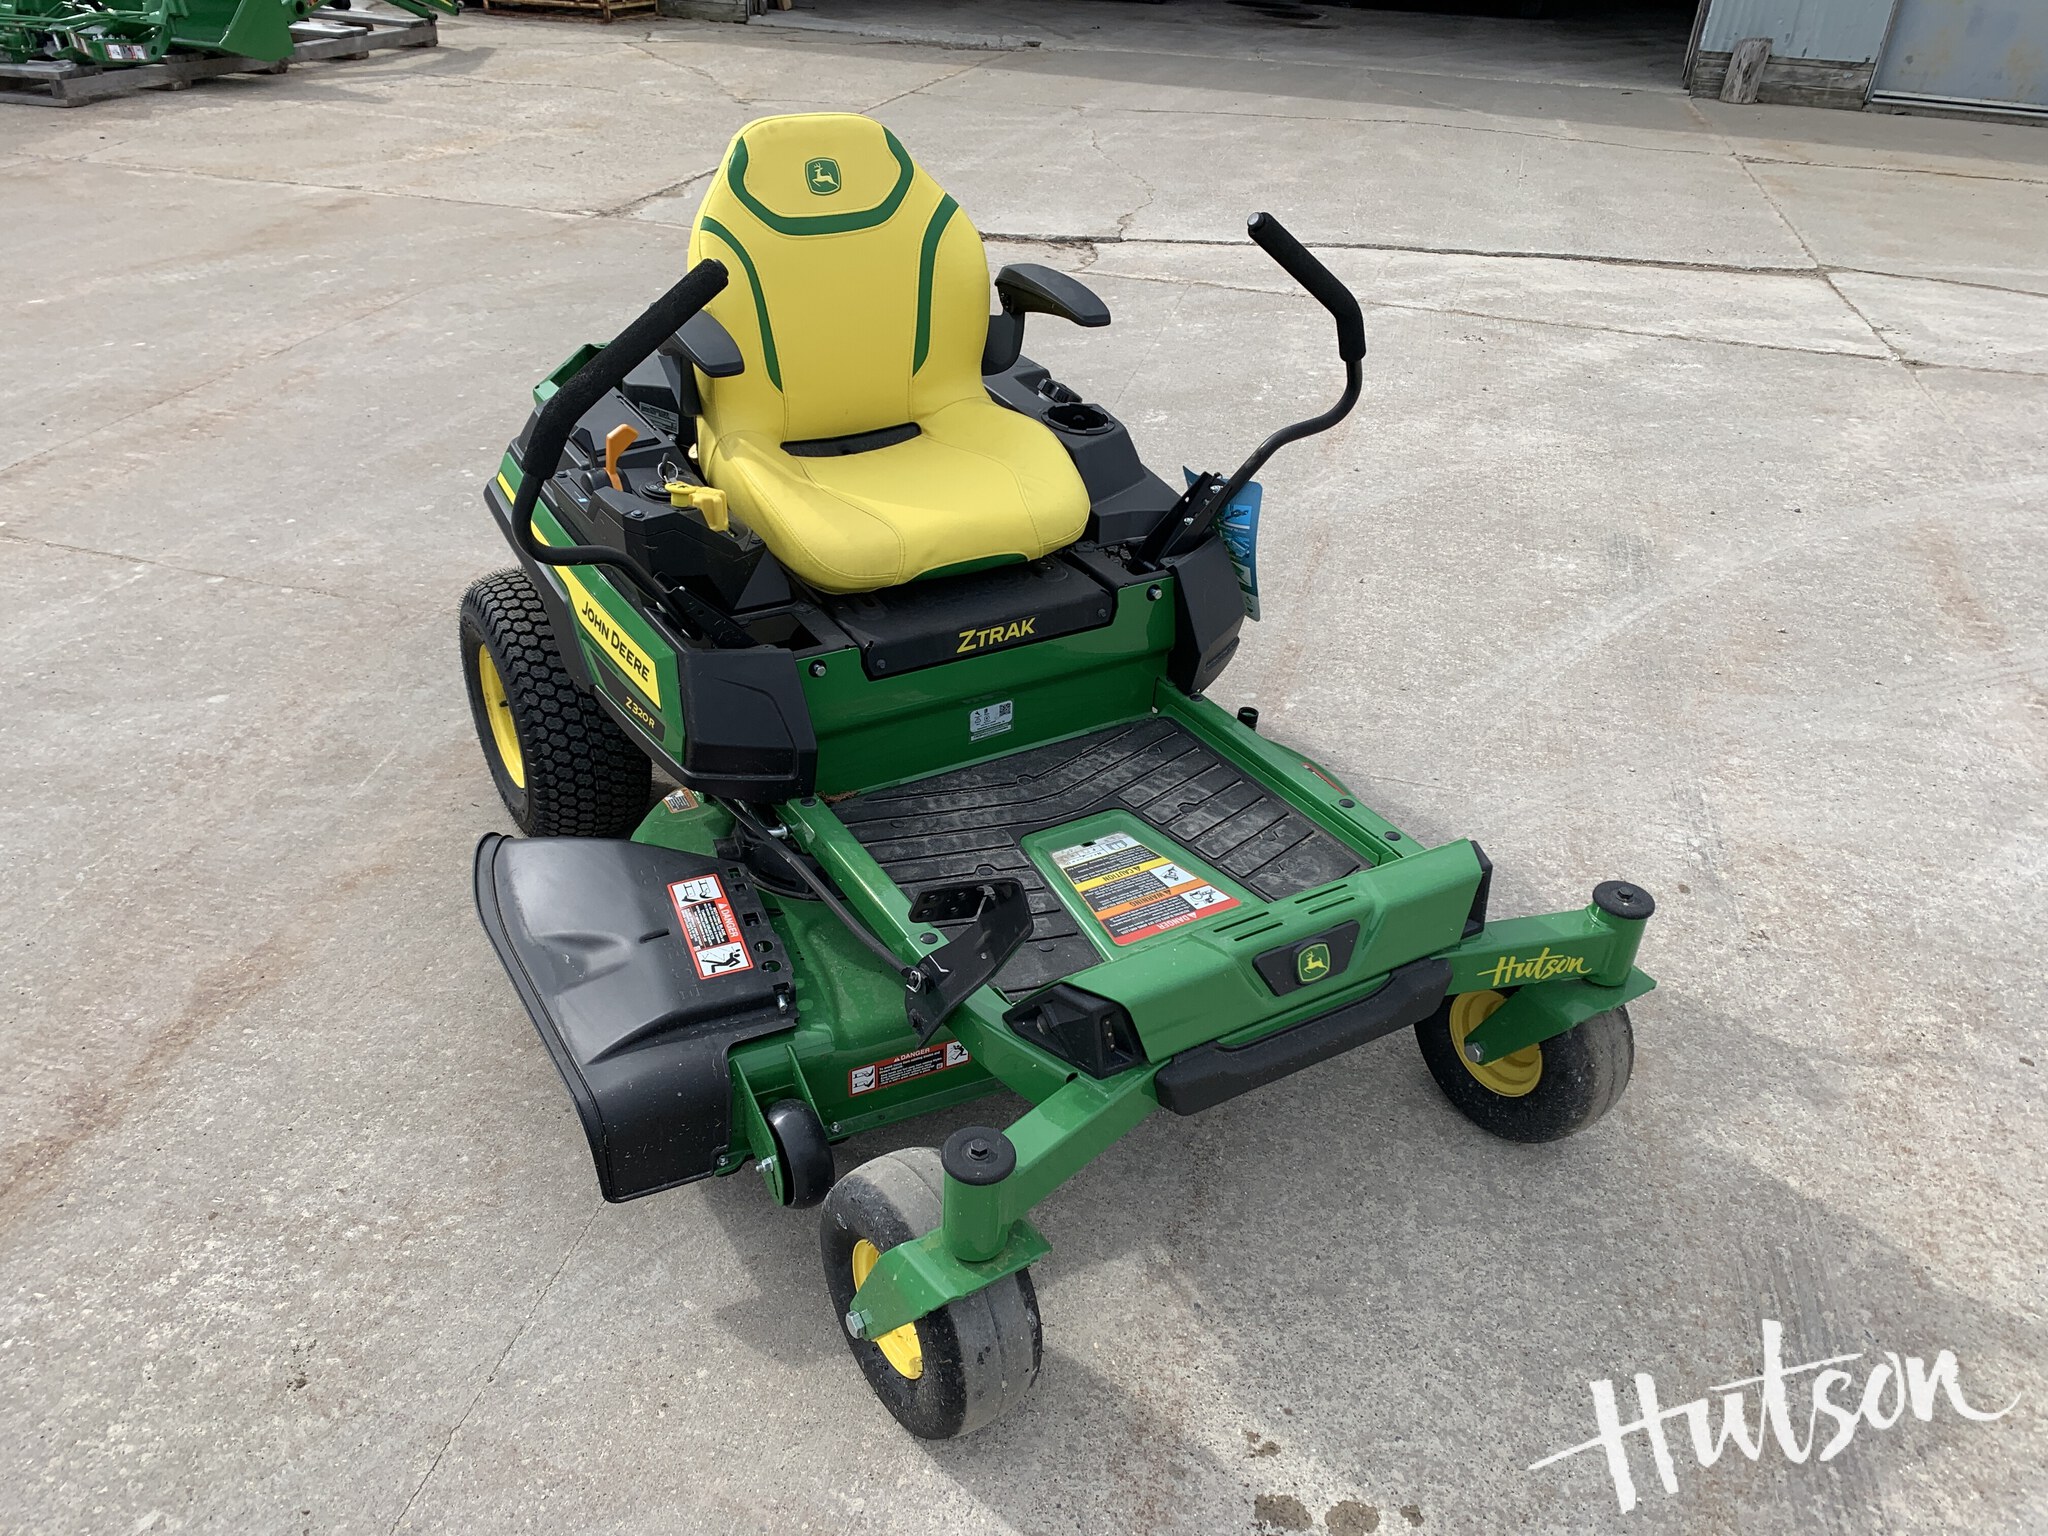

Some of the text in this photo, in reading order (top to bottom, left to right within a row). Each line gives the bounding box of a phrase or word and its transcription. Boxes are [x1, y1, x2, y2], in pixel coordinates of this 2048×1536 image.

[582, 601, 649, 682] JOHN DEERE
[956, 617, 1036, 654] ZTRAK
[1103, 868, 1135, 882] CAUTION
[1129, 890, 1165, 907] WARNING
[721, 909, 739, 938] DANGER
[1156, 915, 1191, 930] DANGER
[1477, 947, 1592, 987] Hutson
[900, 1047, 930, 1061] DANGER
